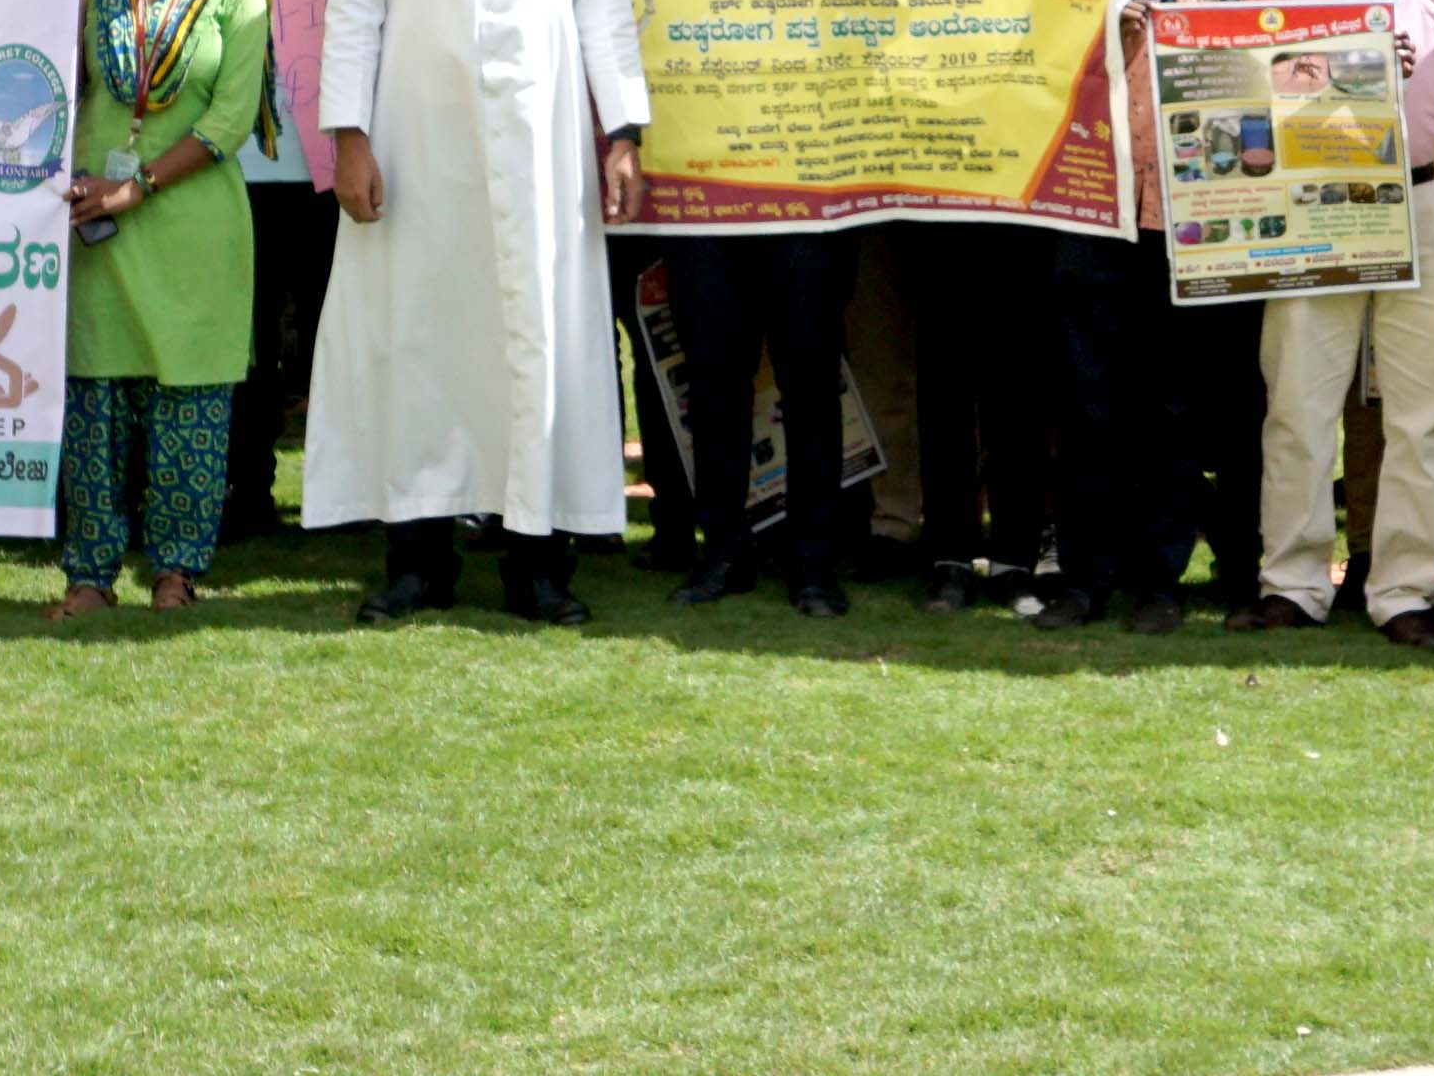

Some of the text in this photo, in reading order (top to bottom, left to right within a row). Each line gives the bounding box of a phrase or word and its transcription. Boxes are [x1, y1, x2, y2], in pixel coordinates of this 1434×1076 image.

[668, 17, 773, 53] ಕುಷ್ಠರೋಗ
[909, 12, 1032, 39] ಆಂದೋಲನ
[25, 51, 62, 93] COLLEGE
[939, 51, 977, 67] 2019
